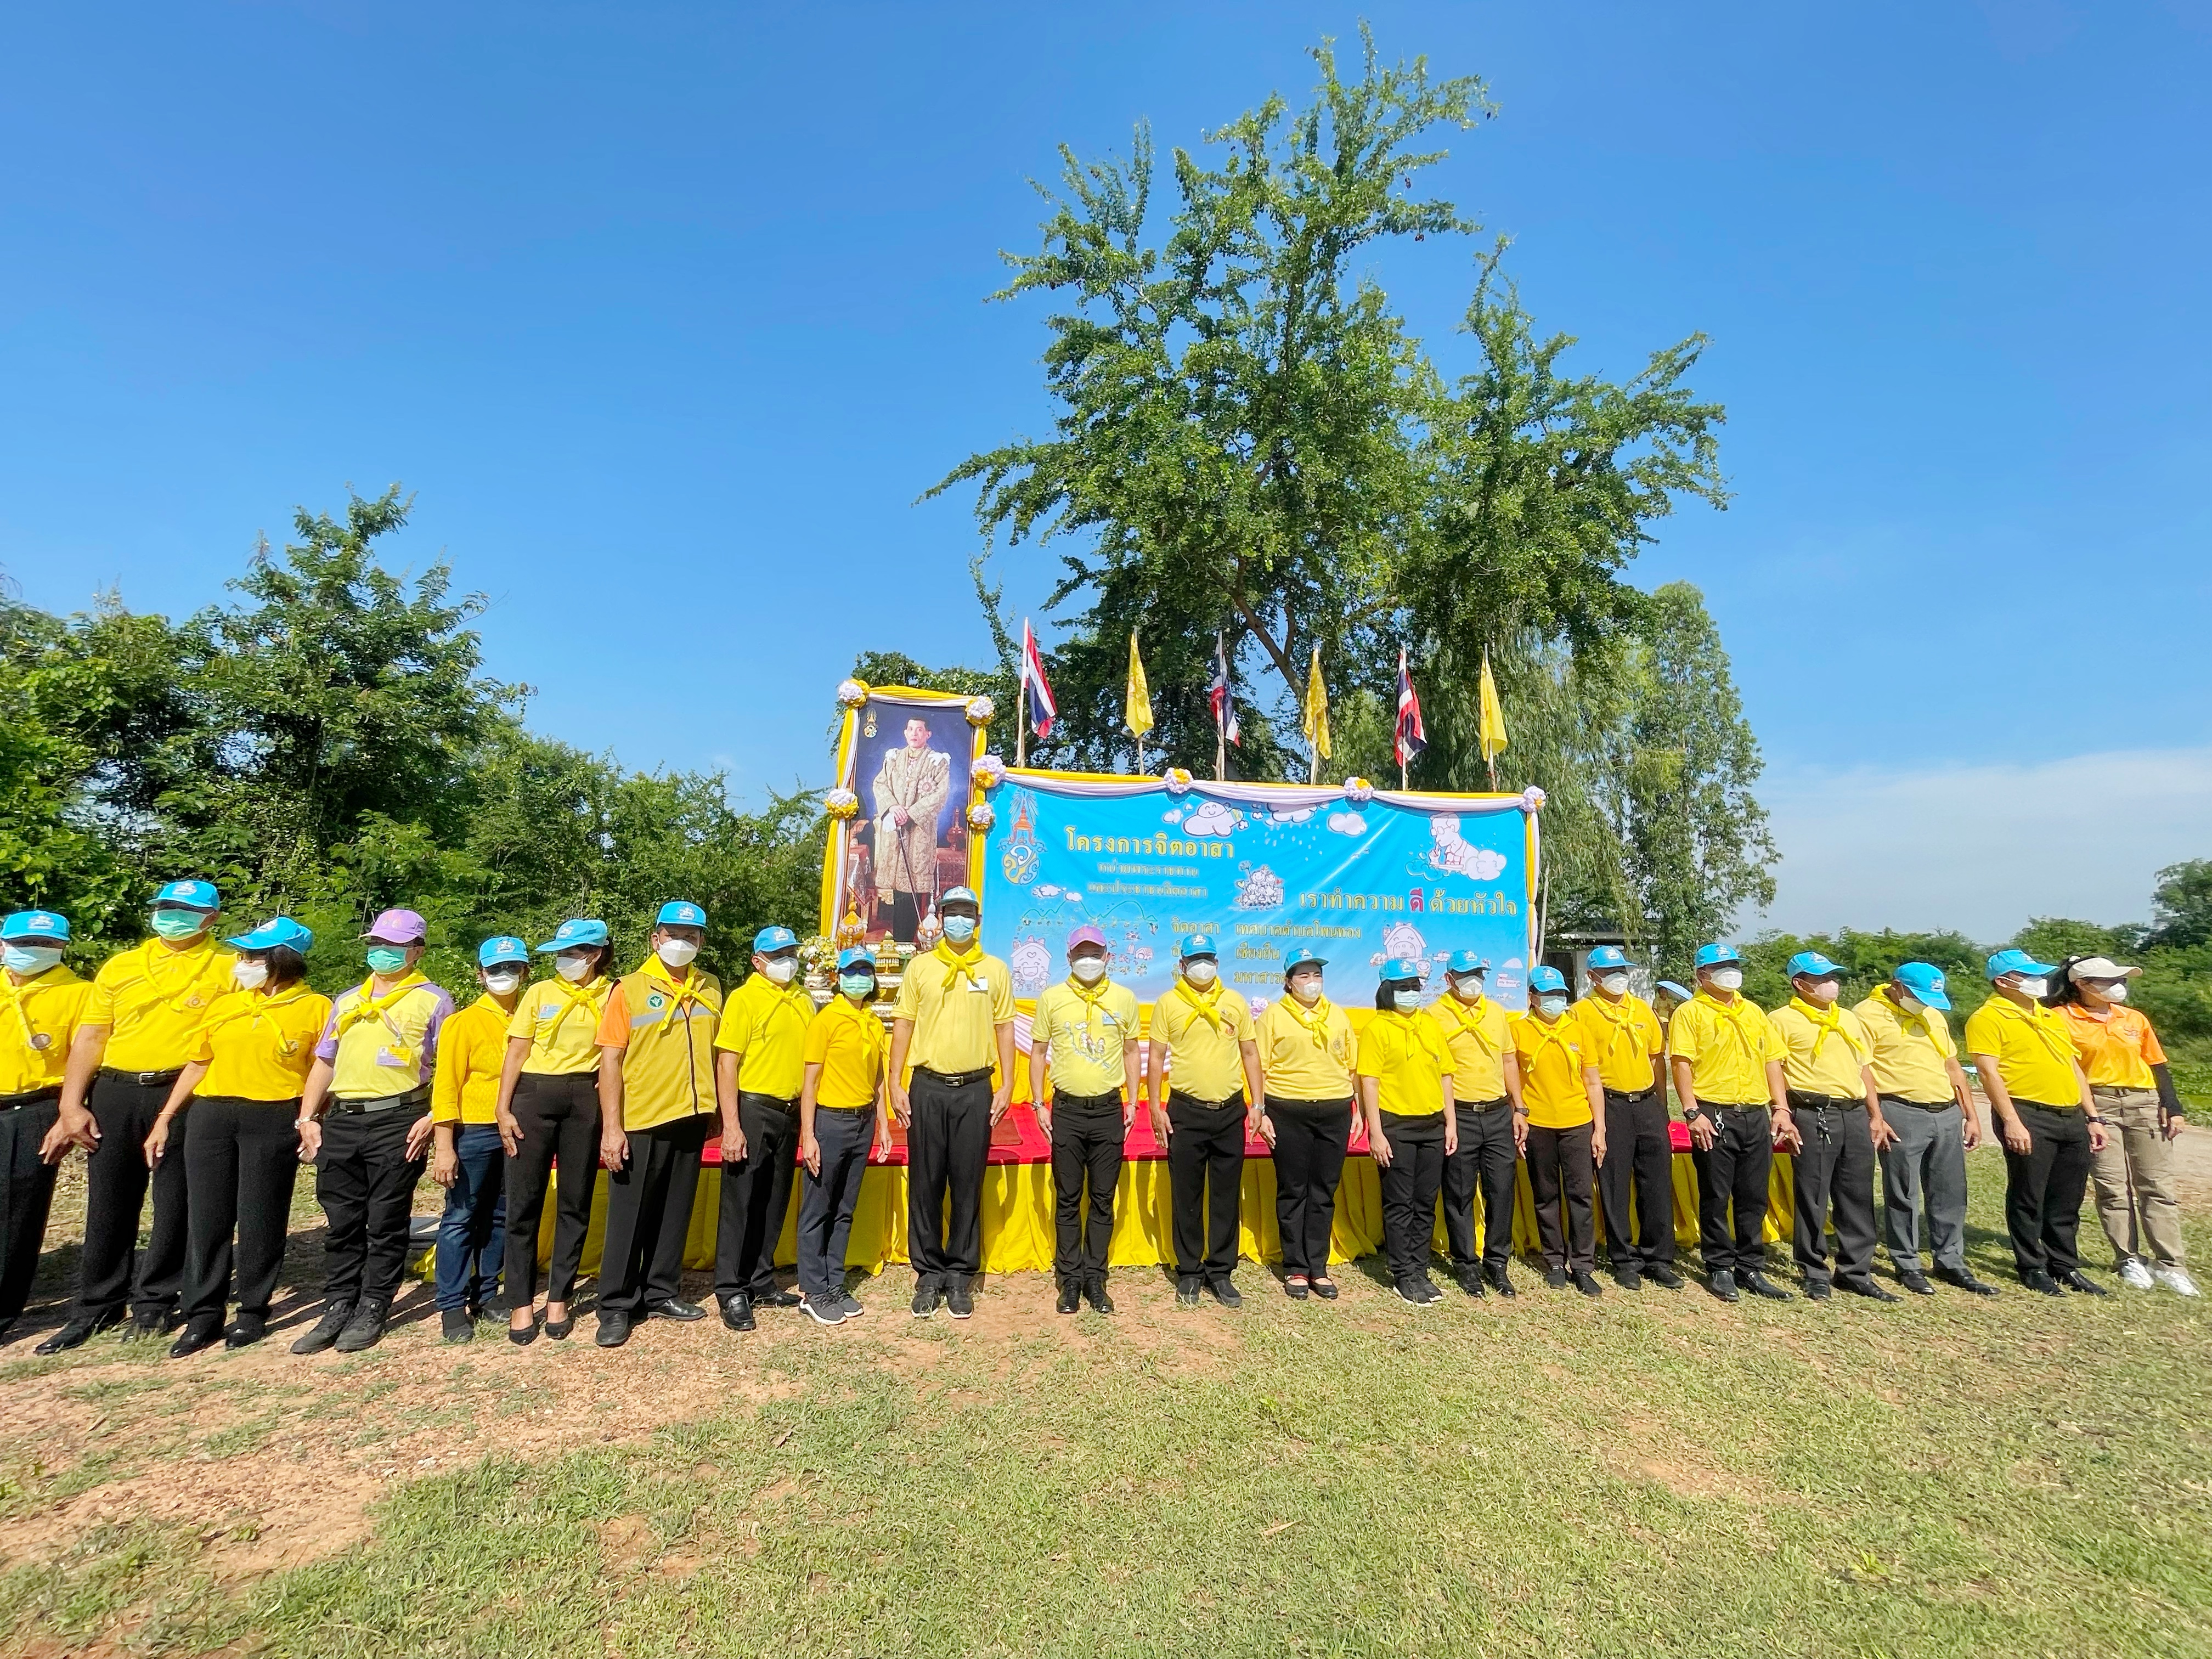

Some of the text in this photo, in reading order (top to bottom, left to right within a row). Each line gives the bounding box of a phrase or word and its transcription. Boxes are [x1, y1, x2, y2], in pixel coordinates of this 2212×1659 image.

[1065, 826, 1234, 859] โครงการจิตอาสา
[1300, 887, 1518, 916] เราทำความ ดี ด้วยหัวใจ
[1171, 916, 1220, 935] จิตอาสา
